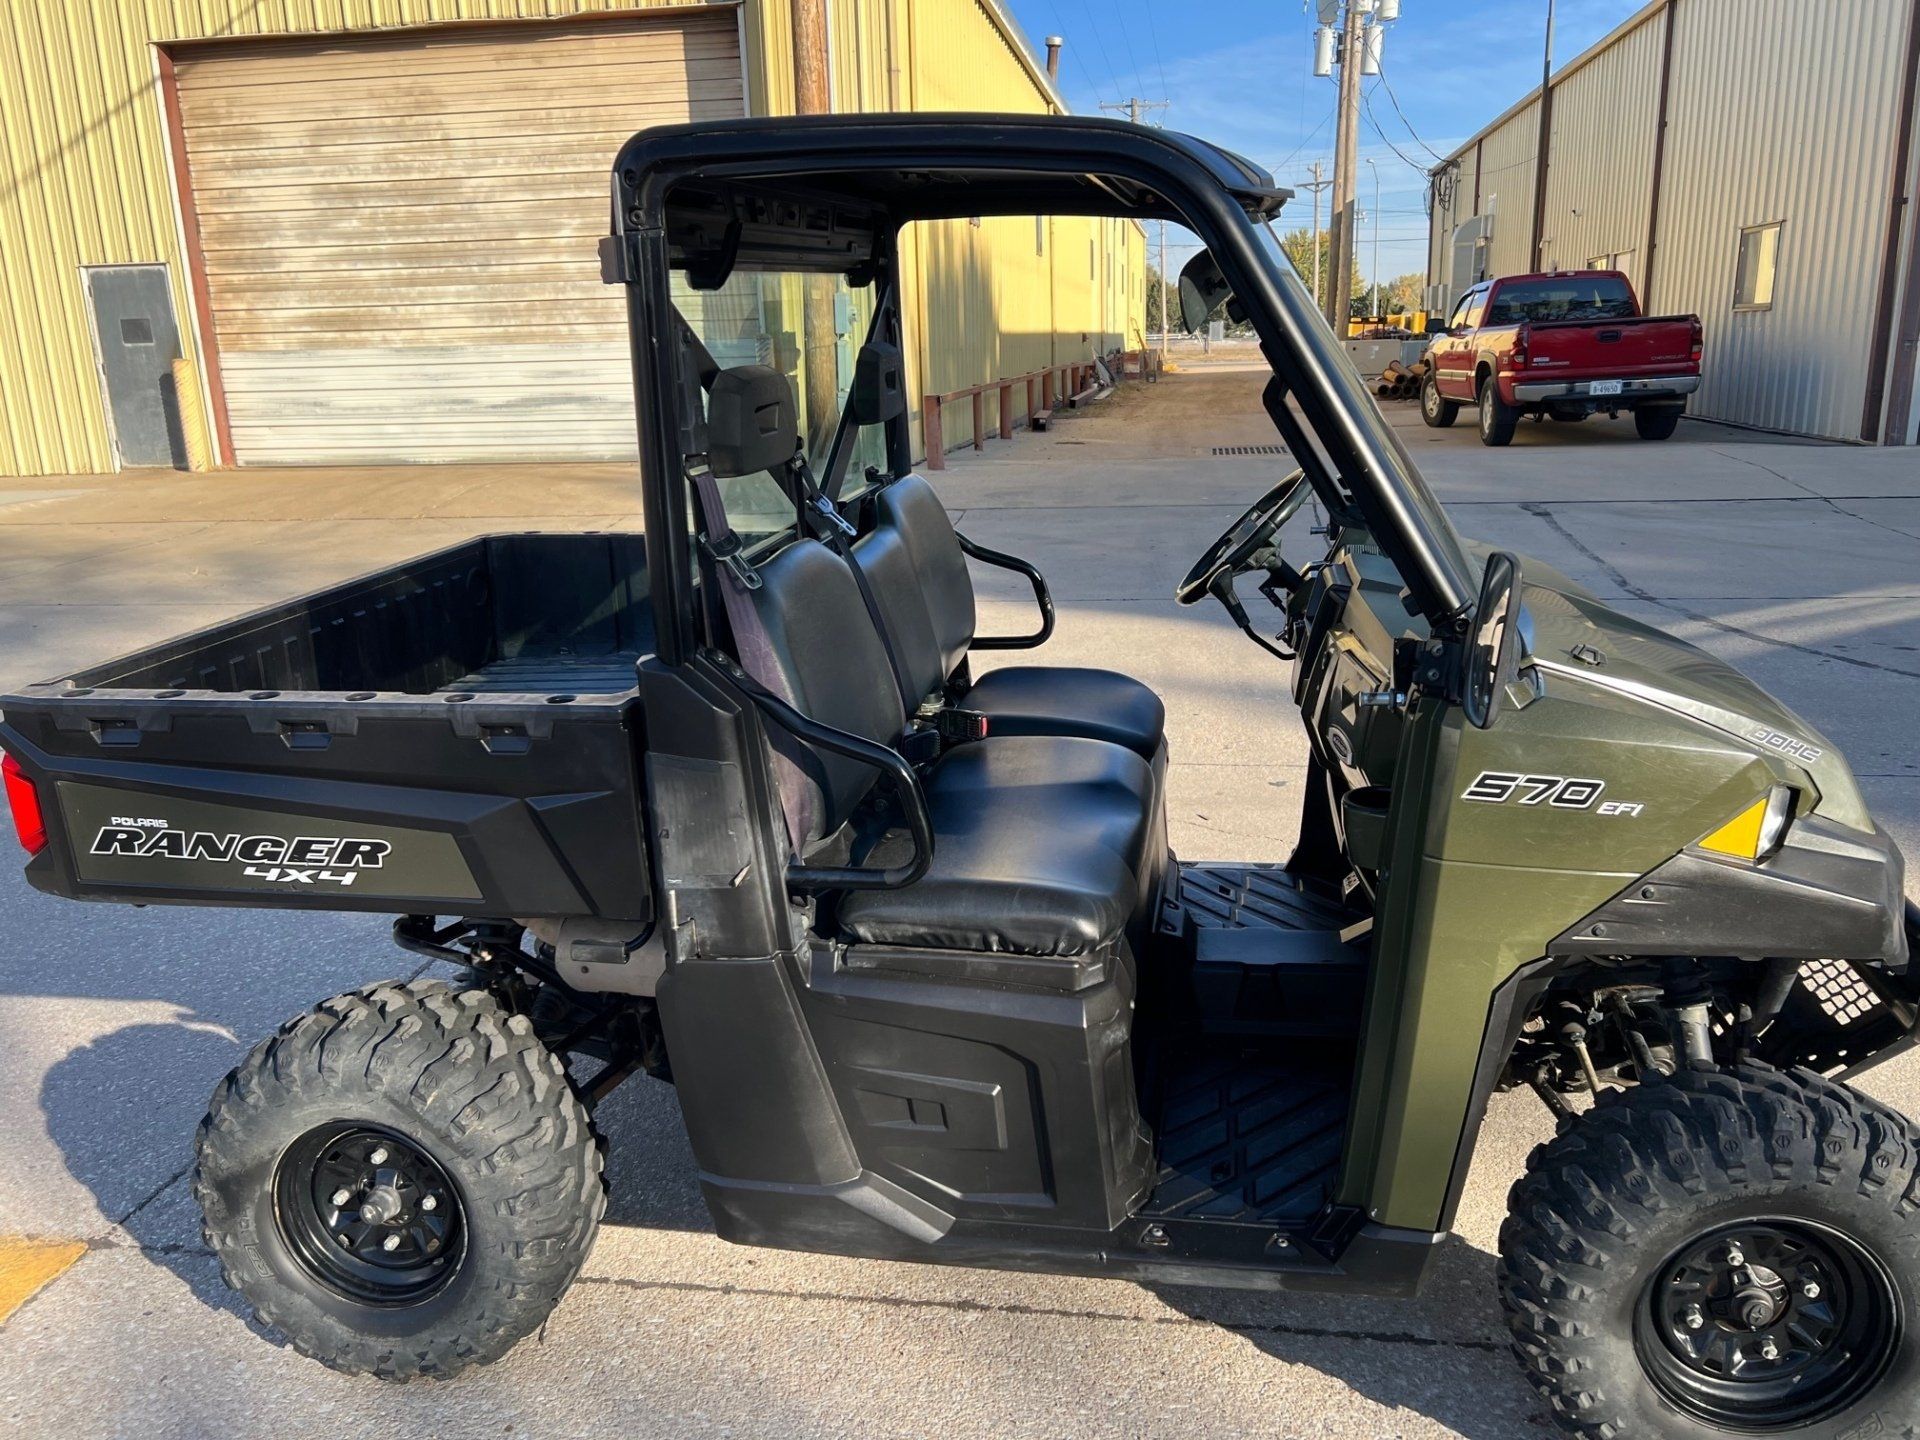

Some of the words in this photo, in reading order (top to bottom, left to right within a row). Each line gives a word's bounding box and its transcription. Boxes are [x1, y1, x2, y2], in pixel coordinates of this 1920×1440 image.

[1461, 771, 1605, 809] 570
[1596, 802, 1644, 817] EFI
[111, 817, 168, 828] POLARIS
[90, 827, 392, 868] RANGER
[243, 867, 357, 885] 4X4
